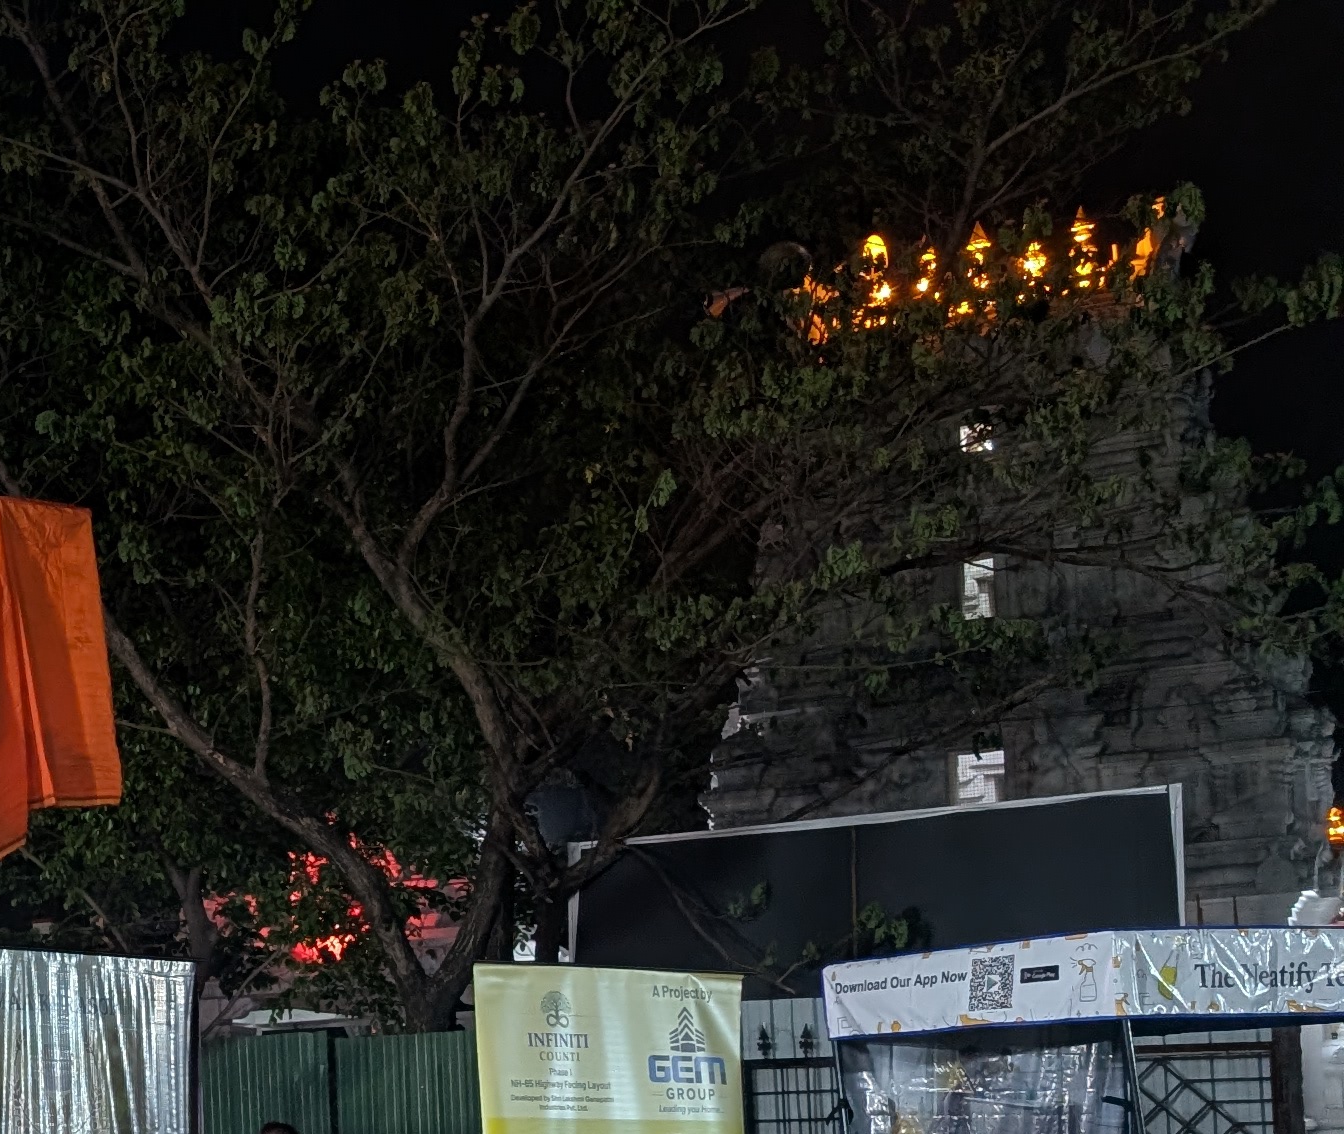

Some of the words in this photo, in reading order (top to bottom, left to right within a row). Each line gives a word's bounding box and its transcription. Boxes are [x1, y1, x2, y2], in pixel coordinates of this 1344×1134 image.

[835, 978, 888, 995] Download
[890, 976, 912, 989] Our
[914, 974, 938, 989] App
[940, 970, 968, 984] Now
[1194, 963, 1235, 988] The
[652, 985, 661, 998] A
[662, 985, 699, 1001] Project
[700, 986, 712, 1003] by
[527, 1033, 589, 1049] INFINITI
[539, 1051, 581, 1062] COUNTI
[648, 1055, 727, 1085] GEM
[587, 1080, 612, 1092] Layout
[666, 1087, 716, 1101] GROUP
[659, 1105, 686, 1115] Leading
